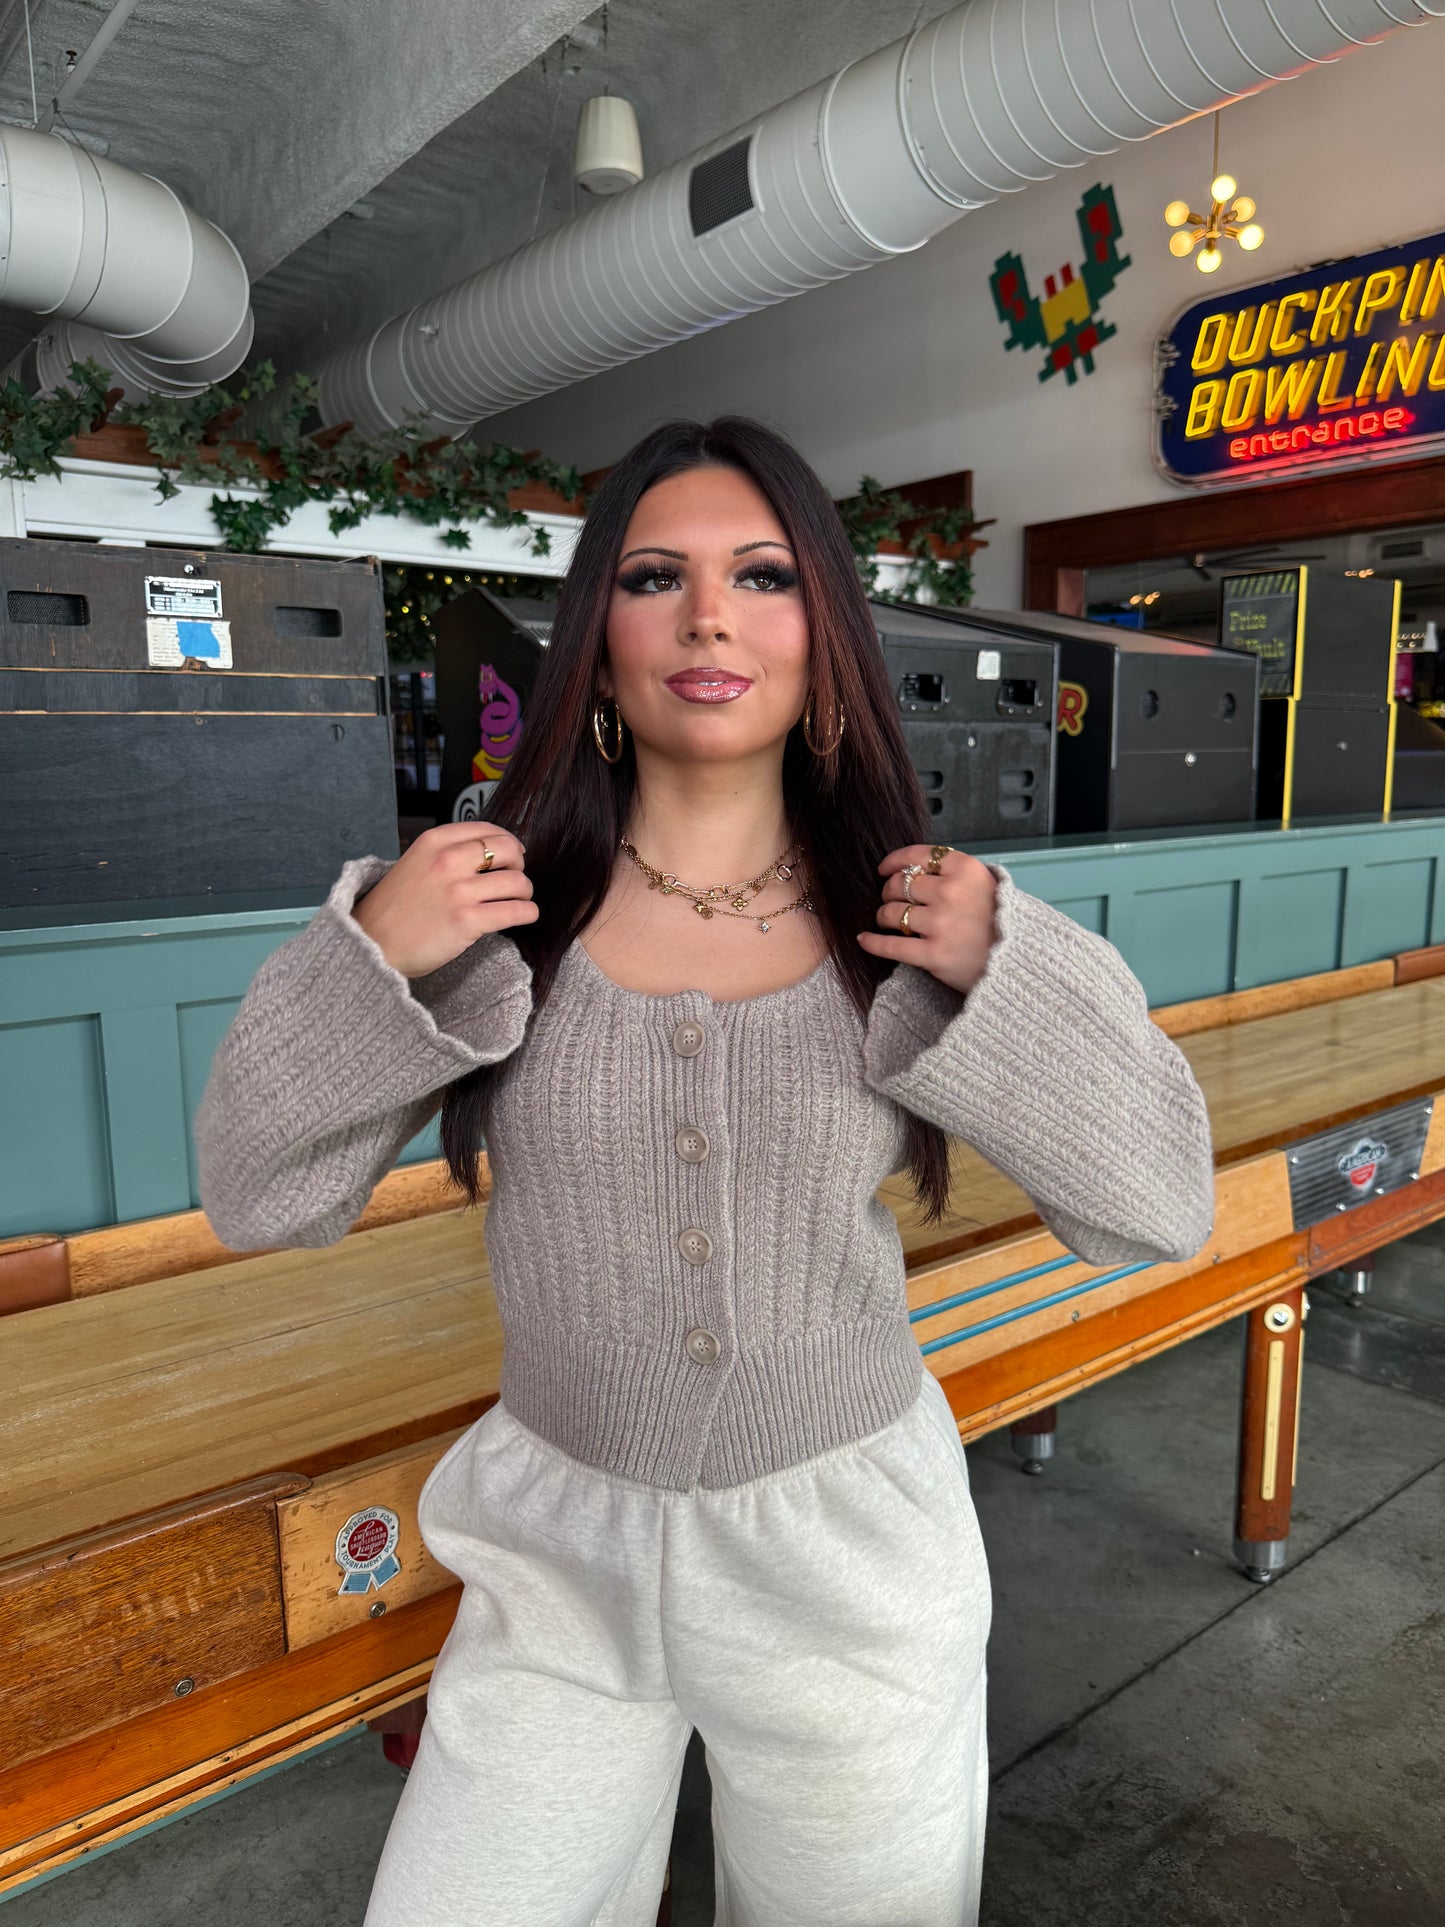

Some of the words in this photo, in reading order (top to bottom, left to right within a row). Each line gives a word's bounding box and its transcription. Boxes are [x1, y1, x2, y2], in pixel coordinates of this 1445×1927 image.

[1229, 407, 1413, 459] entrance
[1229, 611, 1268, 632] Prize
[344, 1511, 377, 1540] APPROVED
[379, 1512, 393, 1525] FOR
[353, 1526, 384, 1543] AMERICAN
[341, 1550, 383, 1570] TOURNAMENT
[384, 1534, 396, 1553] PLAY
